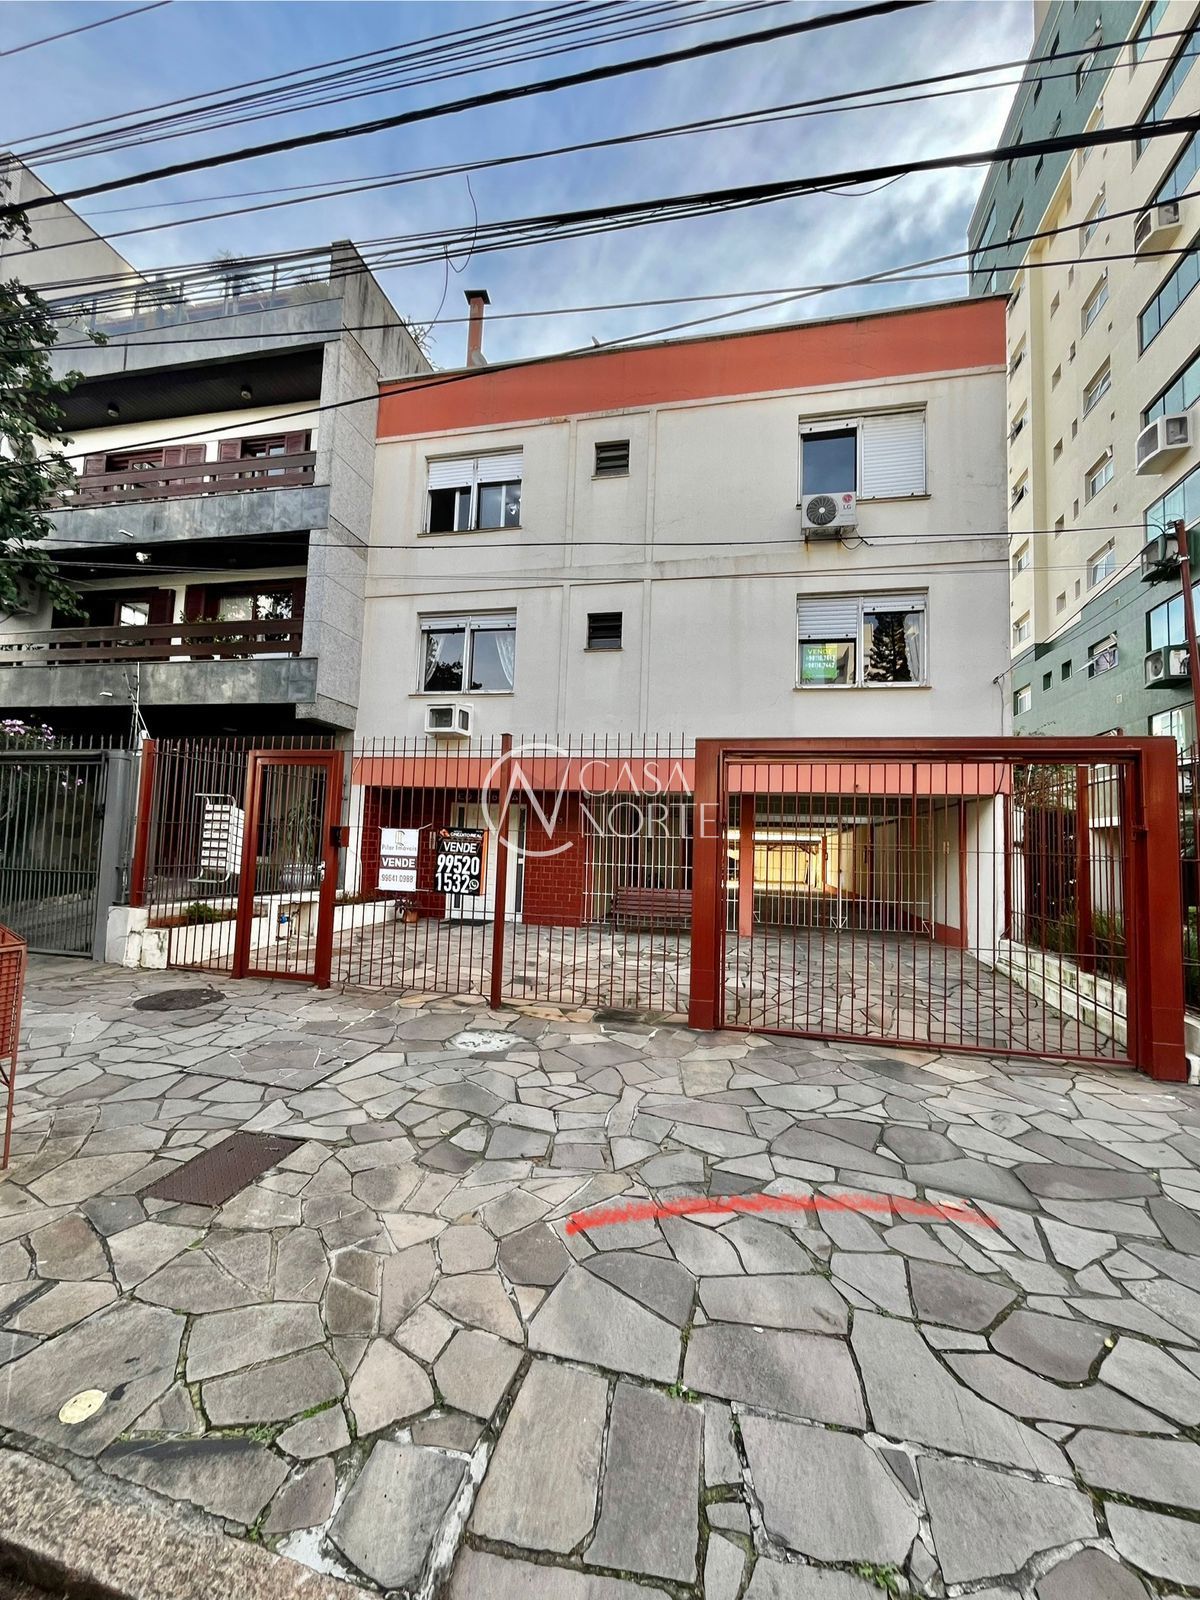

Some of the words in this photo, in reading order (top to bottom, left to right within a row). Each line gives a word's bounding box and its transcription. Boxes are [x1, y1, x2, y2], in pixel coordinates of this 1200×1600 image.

[443, 841, 477, 853] VENDE
[382, 858, 415, 868] VENDE
[437, 854, 480, 875] 99520
[435, 872, 469, 893] 1532
